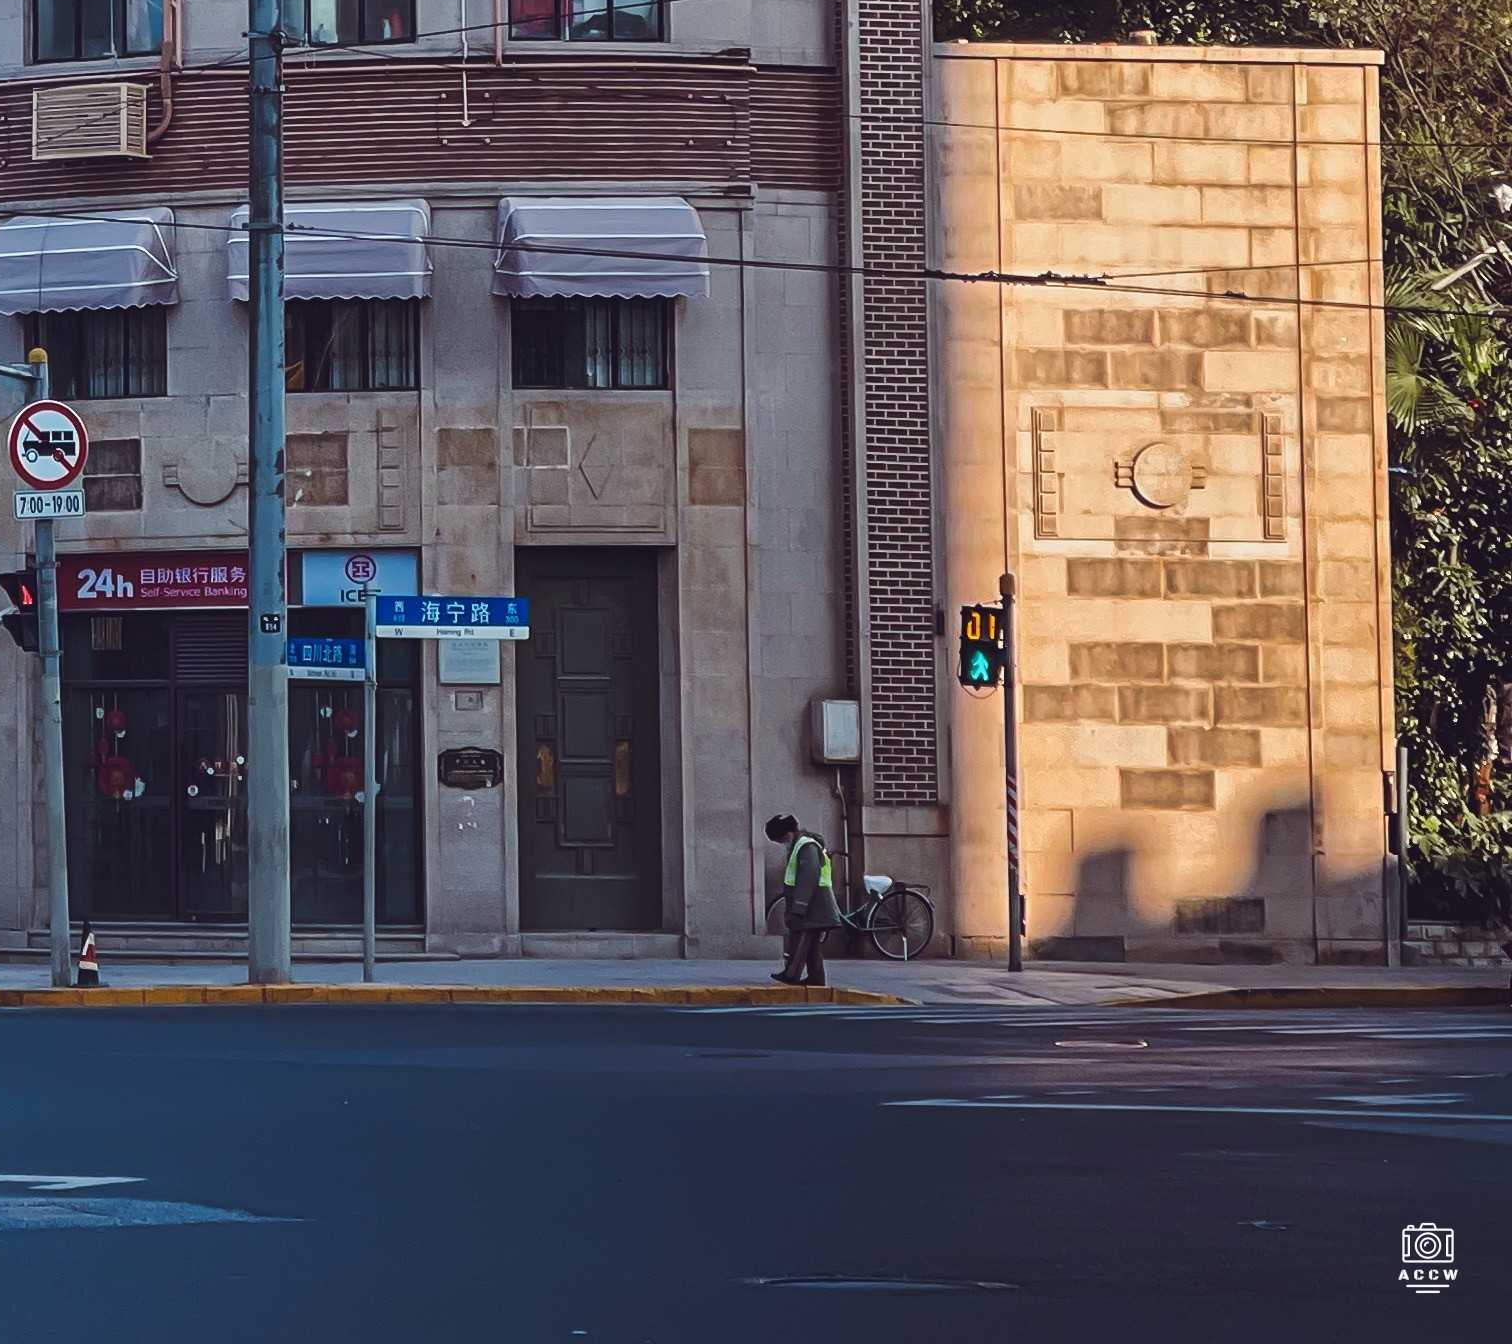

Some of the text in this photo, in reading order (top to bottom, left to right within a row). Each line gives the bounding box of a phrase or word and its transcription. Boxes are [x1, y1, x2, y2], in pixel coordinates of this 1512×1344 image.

[77, 568, 134, 599] 24h
[140, 566, 247, 585] 自助银行服务
[204, 585, 248, 599] Banking
[420, 601, 490, 624] 海宁路
[303, 644, 343, 664] 四川北路
